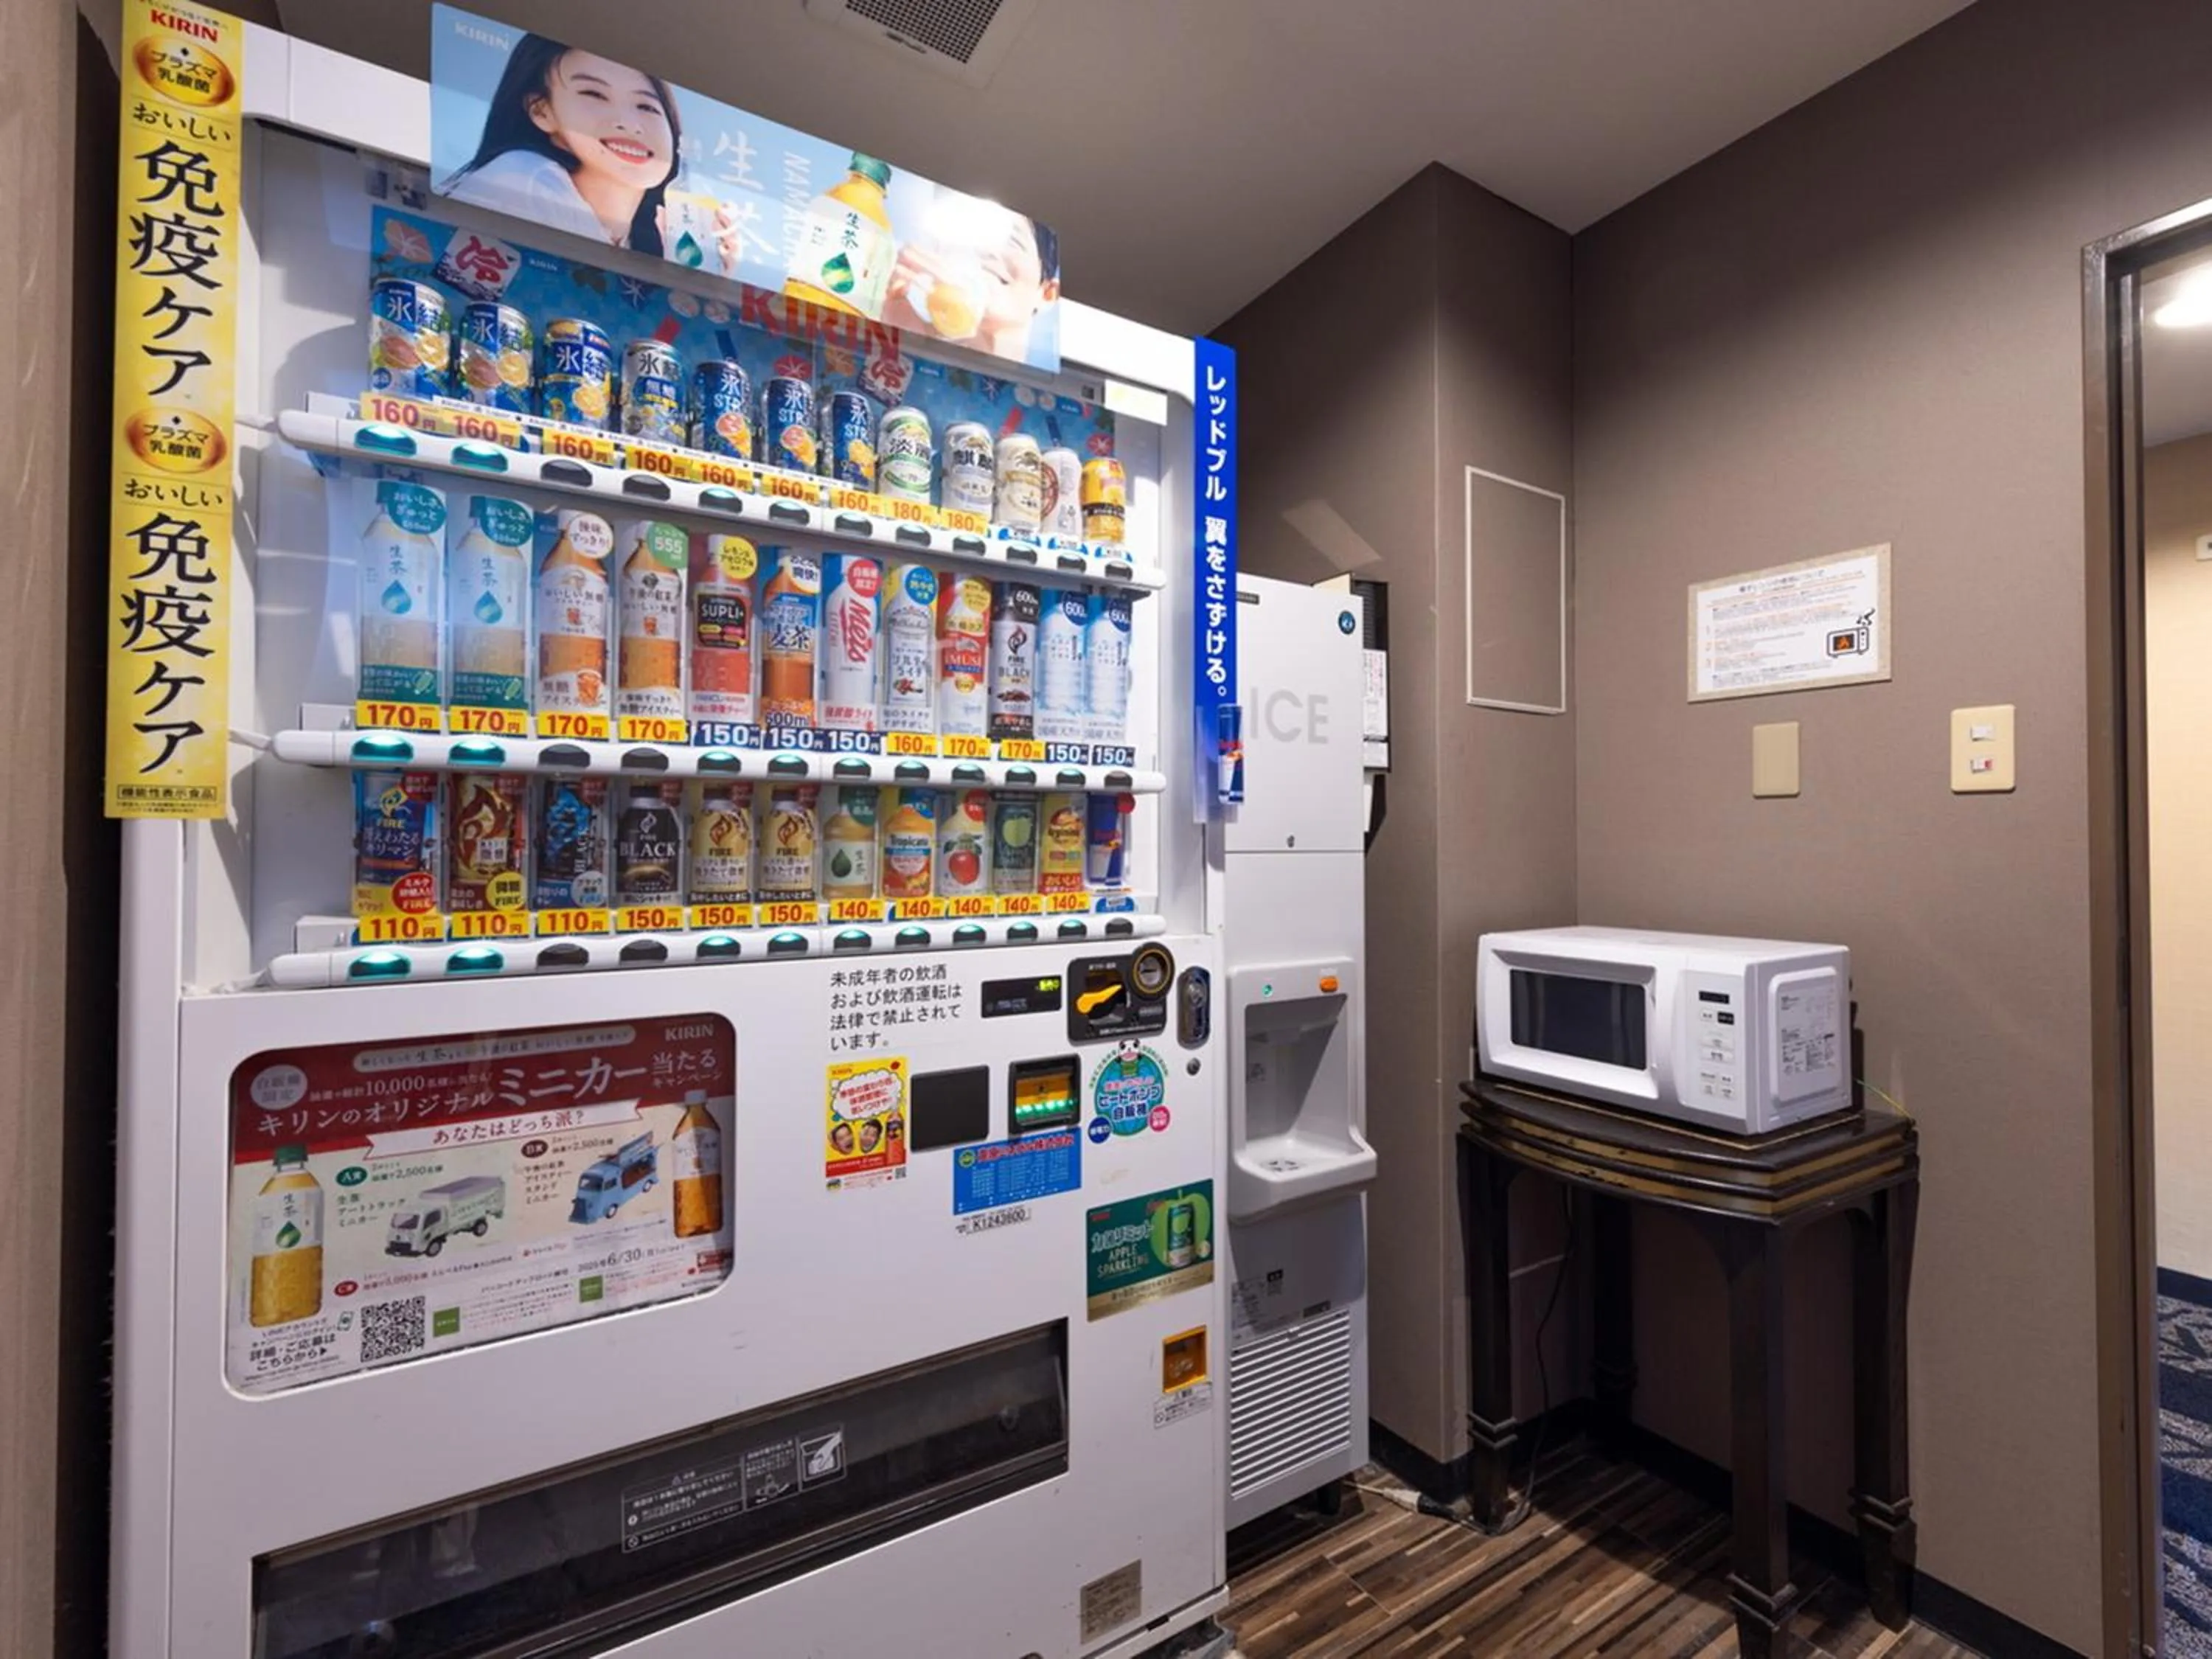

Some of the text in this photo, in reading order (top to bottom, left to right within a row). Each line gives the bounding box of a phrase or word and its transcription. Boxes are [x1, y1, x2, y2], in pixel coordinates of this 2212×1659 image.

[150, 9, 219, 44] KIRIN
[454, 21, 510, 51] KIRIN
[150, 49, 218, 80] プラズマ
[158, 67, 211, 94] 乳酸菌
[133, 102, 231, 141] おいしい
[840, 211, 861, 251] 生茶
[128, 139, 225, 397] 免疫ケア
[386, 296, 440, 330] 氷結
[473, 319, 520, 352] 氷結
[740, 285, 900, 365] KIRIN
[555, 341, 606, 383] 氷結
[371, 398, 436, 431] 160円
[145, 424, 209, 444] プラズマ
[452, 416, 515, 448] 160円
[150, 439, 203, 459] 乳酸菌
[552, 434, 609, 463] 160円
[635, 449, 686, 479] 160円
[701, 464, 748, 490] 160円
[124, 478, 223, 507] おいしい
[770, 477, 815, 502] 160円
[837, 490, 880, 514] 160円
[893, 501, 931, 524] 180円
[948, 513, 984, 534] 180円
[1204, 365, 1228, 698] レッドブル 翼をさずける。
[119, 512, 218, 774] 免疫ケア
[366, 704, 434, 728] 170円
[459, 710, 521, 734] 170円
[546, 714, 602, 737] 170円
[1251, 686, 1329, 745] ICE
[627, 720, 680, 740] 170円
[702, 723, 760, 746] 150円
[770, 728, 824, 748] 150円
[827, 731, 880, 752] 150円
[894, 735, 933, 753] 160円
[949, 739, 987, 756] 170円
[1006, 742, 1042, 759] 170円
[1047, 744, 1088, 762] 150円
[1096, 747, 1134, 765] 150円
[619, 841, 676, 858] BLACK
[836, 902, 879, 919] 140円
[901, 900, 941, 917] 140円
[953, 898, 992, 914] 140円
[1004, 897, 1039, 912] 140円
[1052, 894, 1086, 910] 140円
[462, 914, 523, 936] 110円
[546, 912, 604, 932] 110円
[626, 908, 679, 928] 150円
[699, 906, 748, 925] 150円
[768, 905, 813, 923] 150円
[370, 917, 437, 939] 110円
[830, 964, 947, 987] 未成年者の飲酒
[830, 984, 963, 1010] および飲酒運転は
[830, 1004, 961, 1031] 法律で禁止されて
[665, 1024, 714, 1041] KIRIN
[830, 1032, 888, 1052] います。
[652, 1071, 722, 1088] キャンペーン
[258, 1048, 717, 1136] キリンのオリジナル ミニカー 当たる
[1098, 1085, 1162, 1107] ヒートポンプ
[1113, 1103, 1149, 1121] 自販機
[432, 1109, 585, 1144] あなたはどっち派?
[1109, 1243, 1138, 1262] APPLE
[249, 1332, 336, 1362] 詳細・ご応募は
[257, 1349, 319, 1371] こちらから
